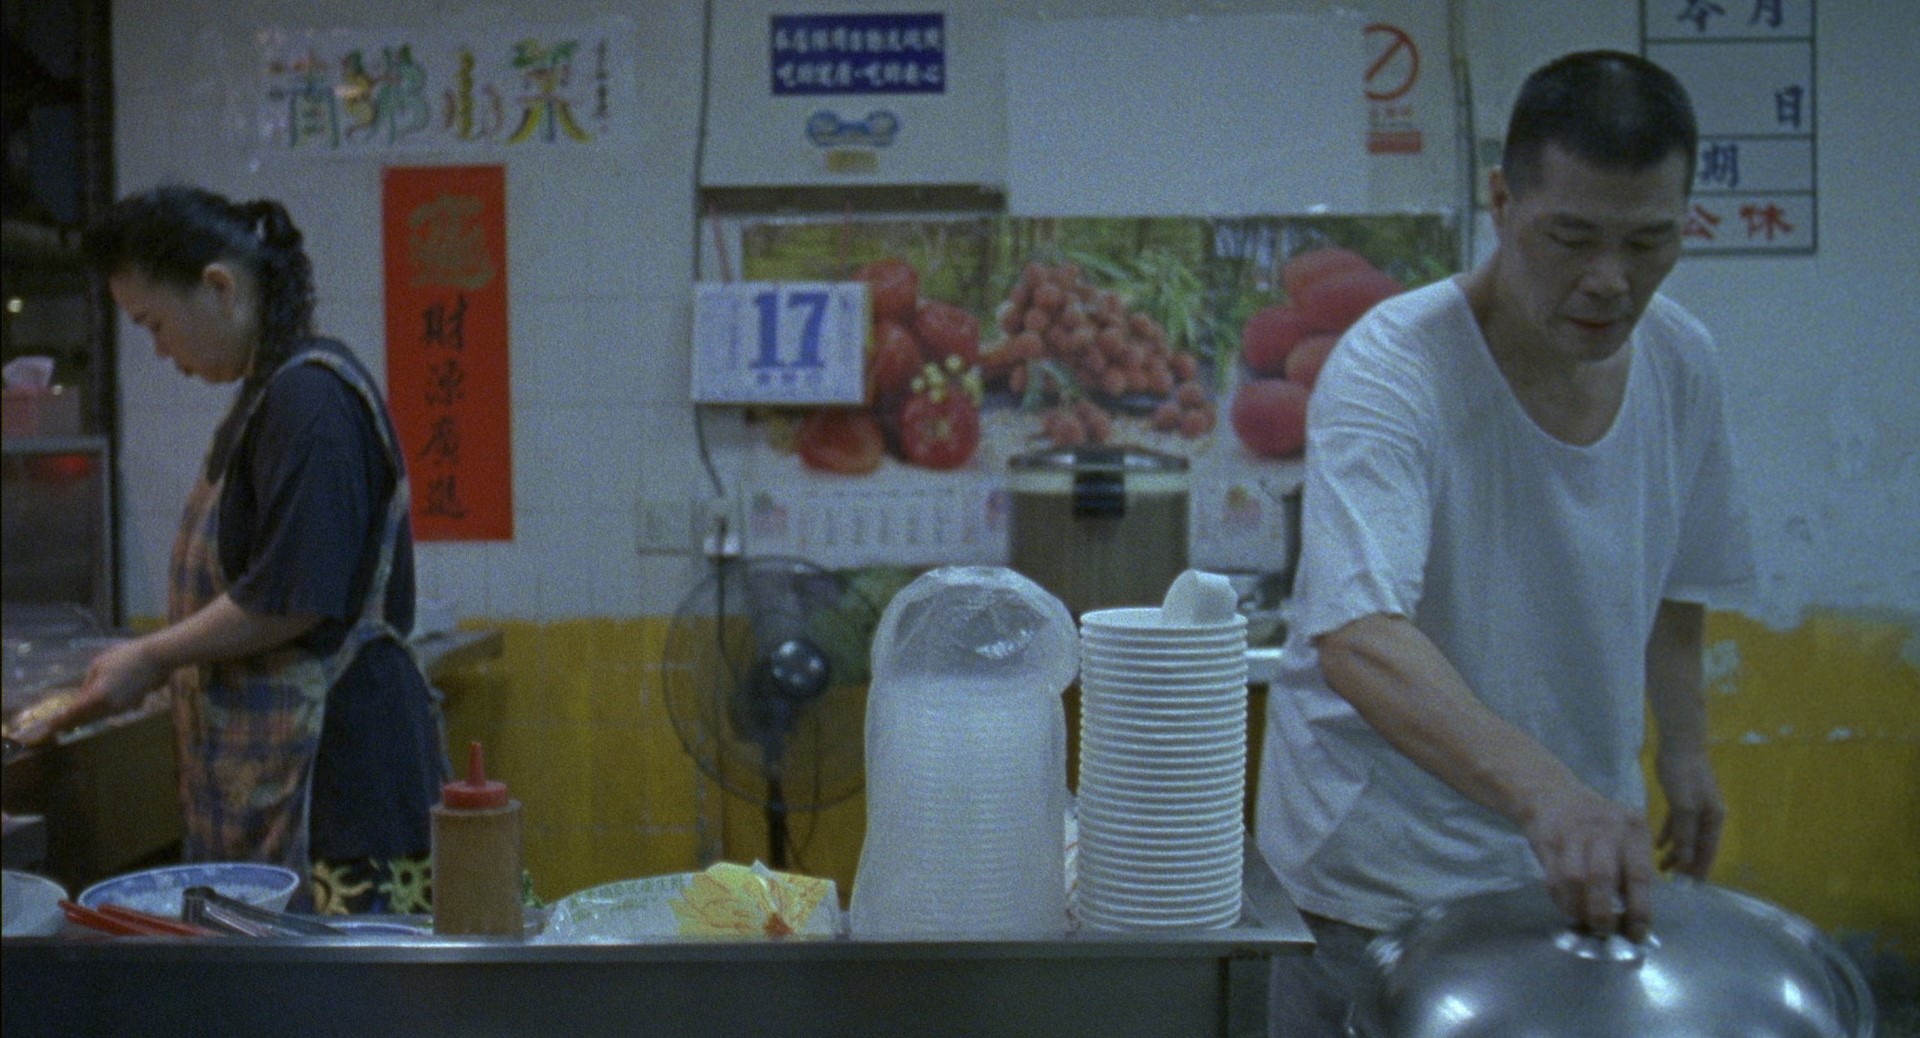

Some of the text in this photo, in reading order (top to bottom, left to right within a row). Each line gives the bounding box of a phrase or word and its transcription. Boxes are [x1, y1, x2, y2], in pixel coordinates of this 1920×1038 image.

[1774, 84, 1804, 127] 日
[1681, 203, 1794, 241] 公休
[750, 289, 830, 369] 17
